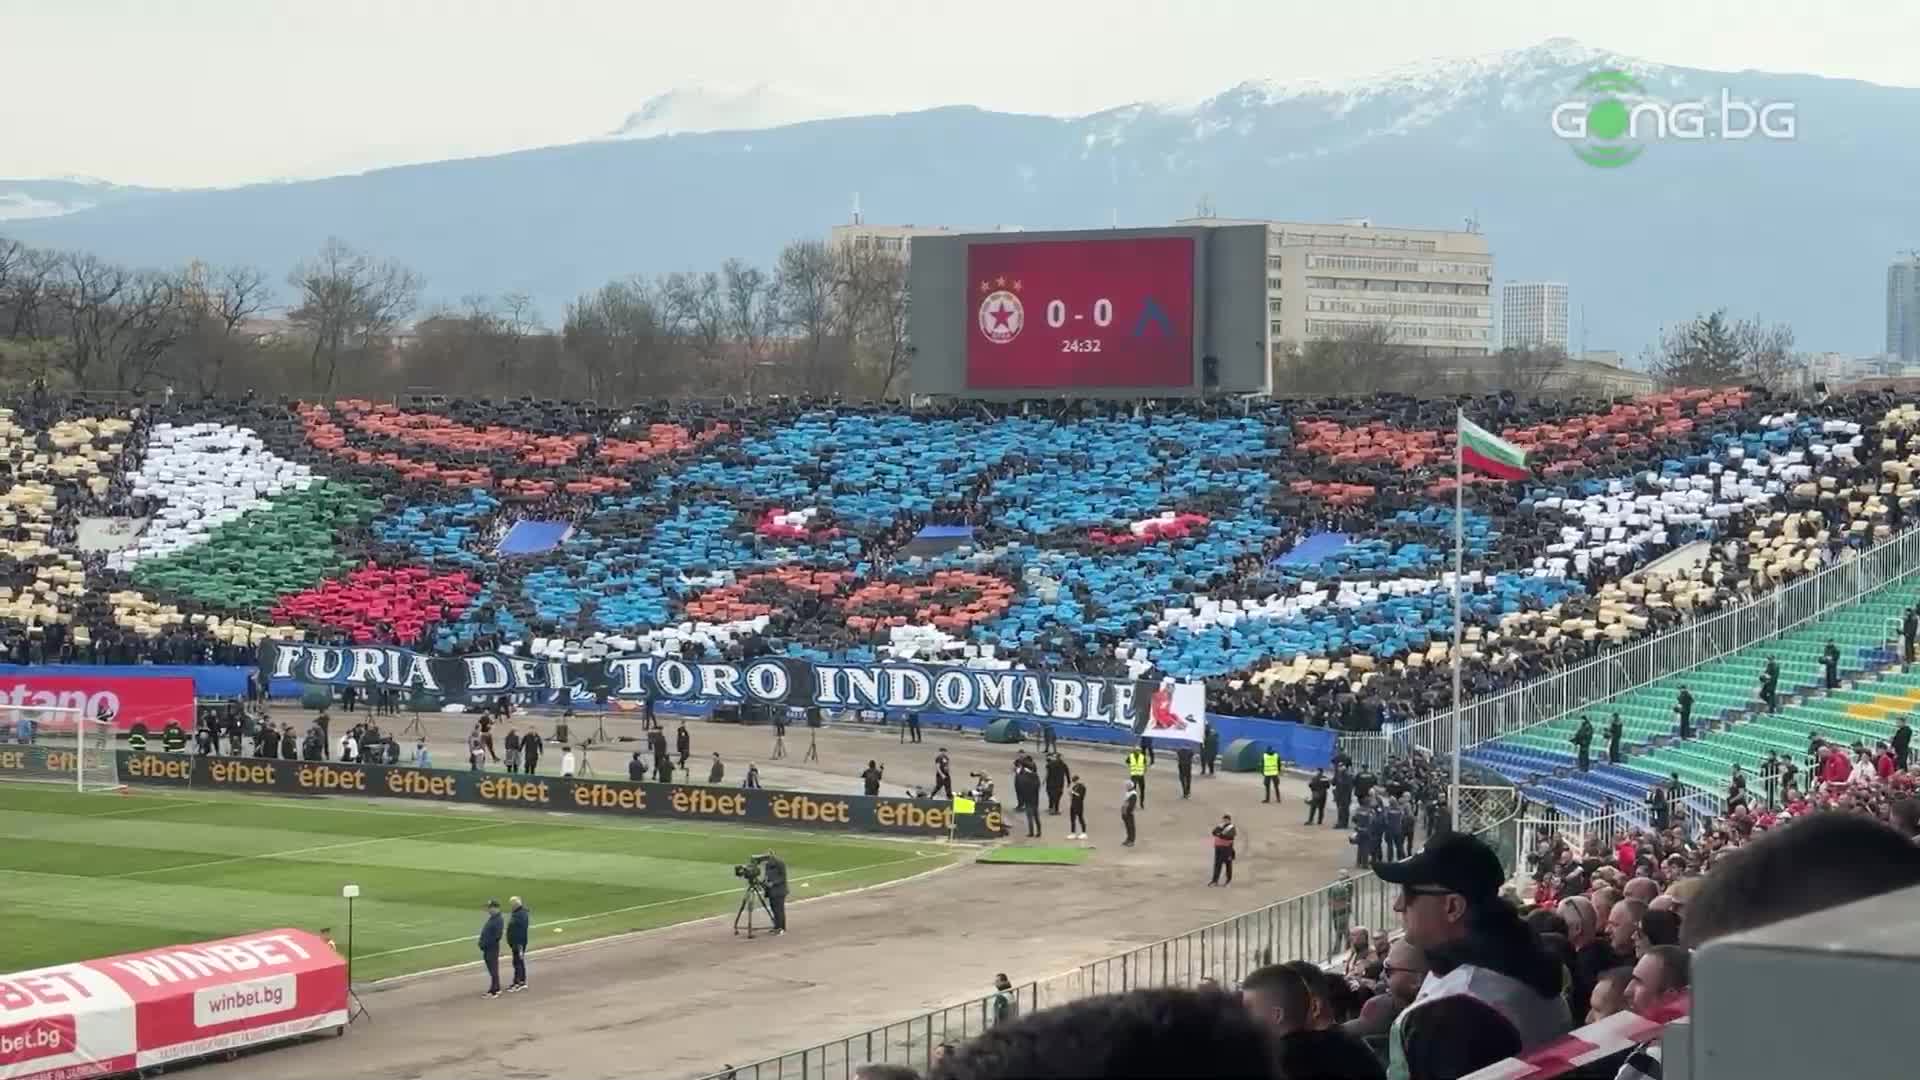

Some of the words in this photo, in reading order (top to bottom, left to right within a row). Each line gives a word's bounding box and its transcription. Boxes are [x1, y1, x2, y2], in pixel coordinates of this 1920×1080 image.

[1047, 299, 1066, 328] 0
[1093, 298, 1113, 327] 0
[1062, 339, 1102, 353] 24:32
[272, 643, 439, 691] FURIA
[467, 657, 578, 690] DEL
[610, 656, 788, 699] TORO
[814, 667, 1136, 728] INDOMABLE
[127, 756, 190, 779] efbet
[210, 760, 276, 784] efbet
[298, 765, 366, 790] efbet
[387, 770, 457, 796] efbet
[478, 776, 550, 802] efbet
[573, 783, 647, 810] efbet
[670, 788, 747, 816] efbet
[770, 795, 850, 823] efbet
[112, 934, 311, 986] WINBET
[208, 986, 283, 1014] winbet.bg
